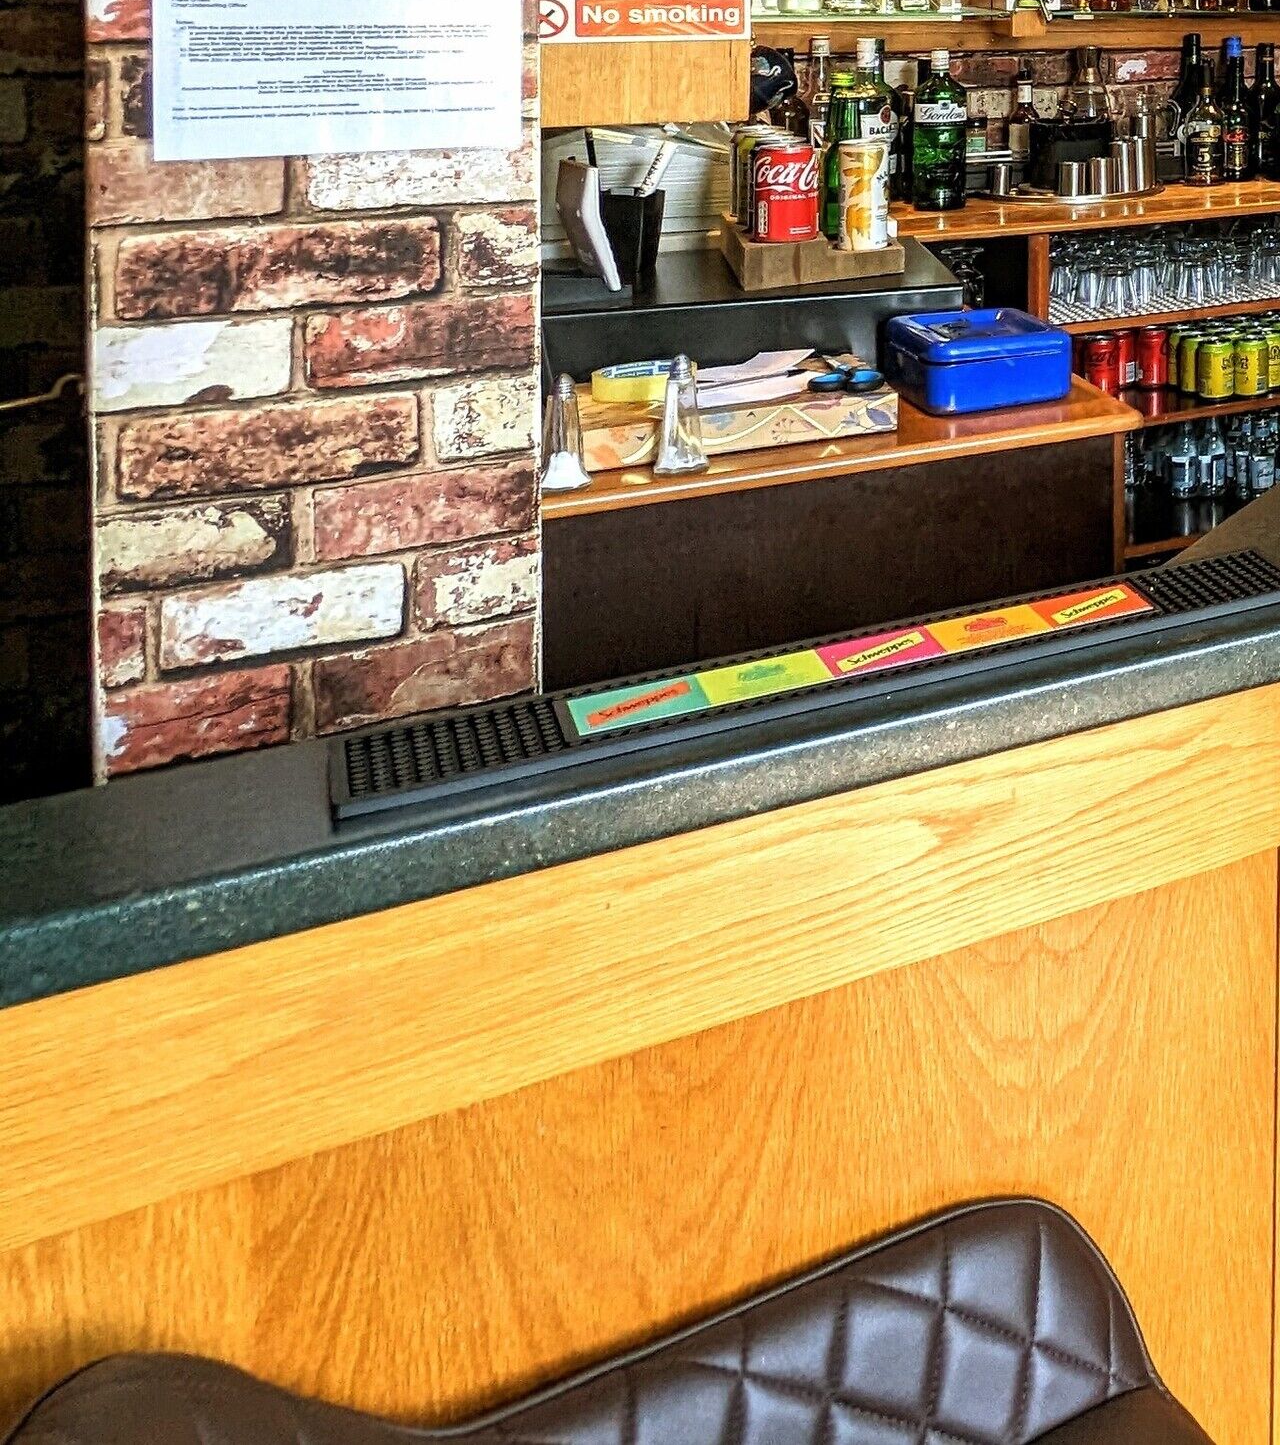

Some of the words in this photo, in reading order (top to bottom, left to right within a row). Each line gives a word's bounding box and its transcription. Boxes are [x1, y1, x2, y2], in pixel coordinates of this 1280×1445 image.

[582, 4, 620, 24] No
[628, 3, 740, 27] smoking
[1197, 147, 1211, 163] 5
[1059, 591, 1118, 619] Schweppes
[847, 637, 915, 667] Schweppes
